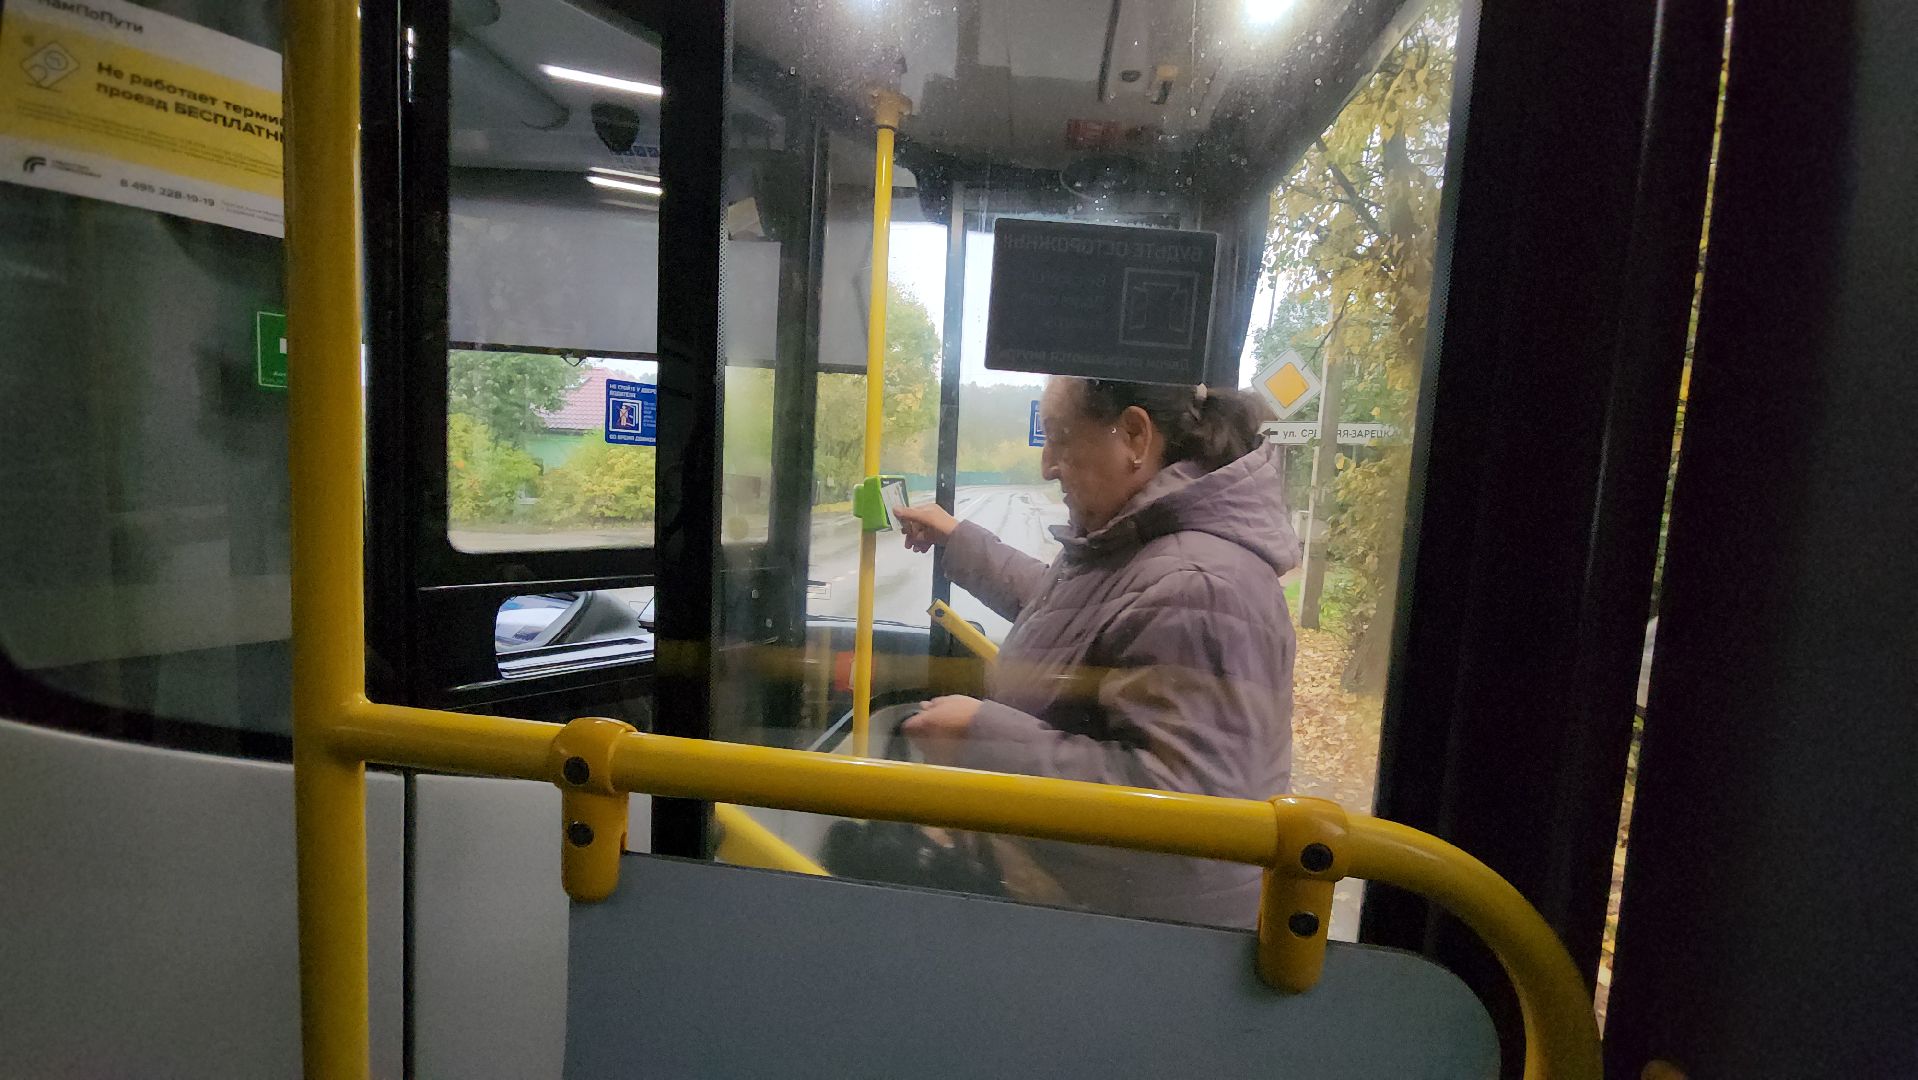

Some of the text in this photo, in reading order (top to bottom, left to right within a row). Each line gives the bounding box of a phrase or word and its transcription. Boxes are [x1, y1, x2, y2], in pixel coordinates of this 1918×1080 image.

[96, 82, 168, 112] проезд
[97, 61, 284, 126] Не работает терми
[131, 181, 156, 194] 495
[1283, 428, 1398, 439] ул. СРЯЯ-ЗАРЕЦК
